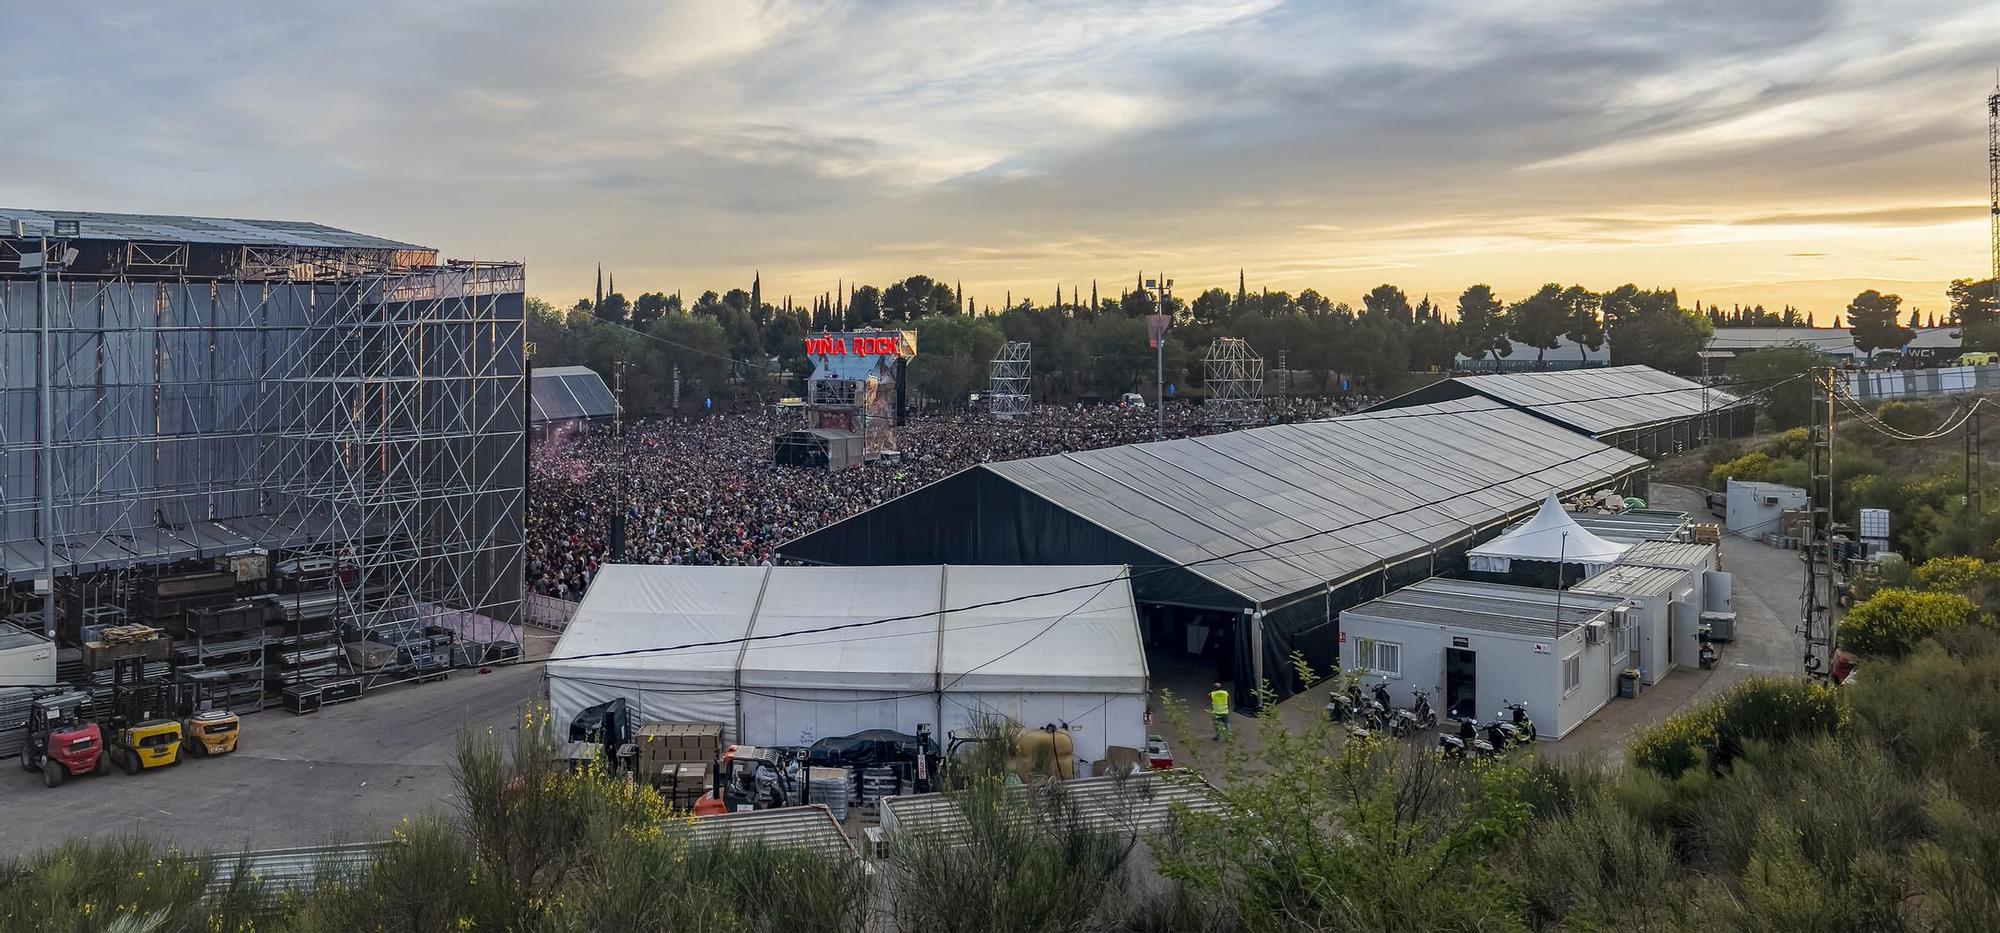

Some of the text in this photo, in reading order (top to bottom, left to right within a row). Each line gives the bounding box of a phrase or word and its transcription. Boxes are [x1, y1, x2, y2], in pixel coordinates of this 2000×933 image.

[805, 334, 899, 357] VIÑA ROCK
[1908, 349, 1930, 357] WC
